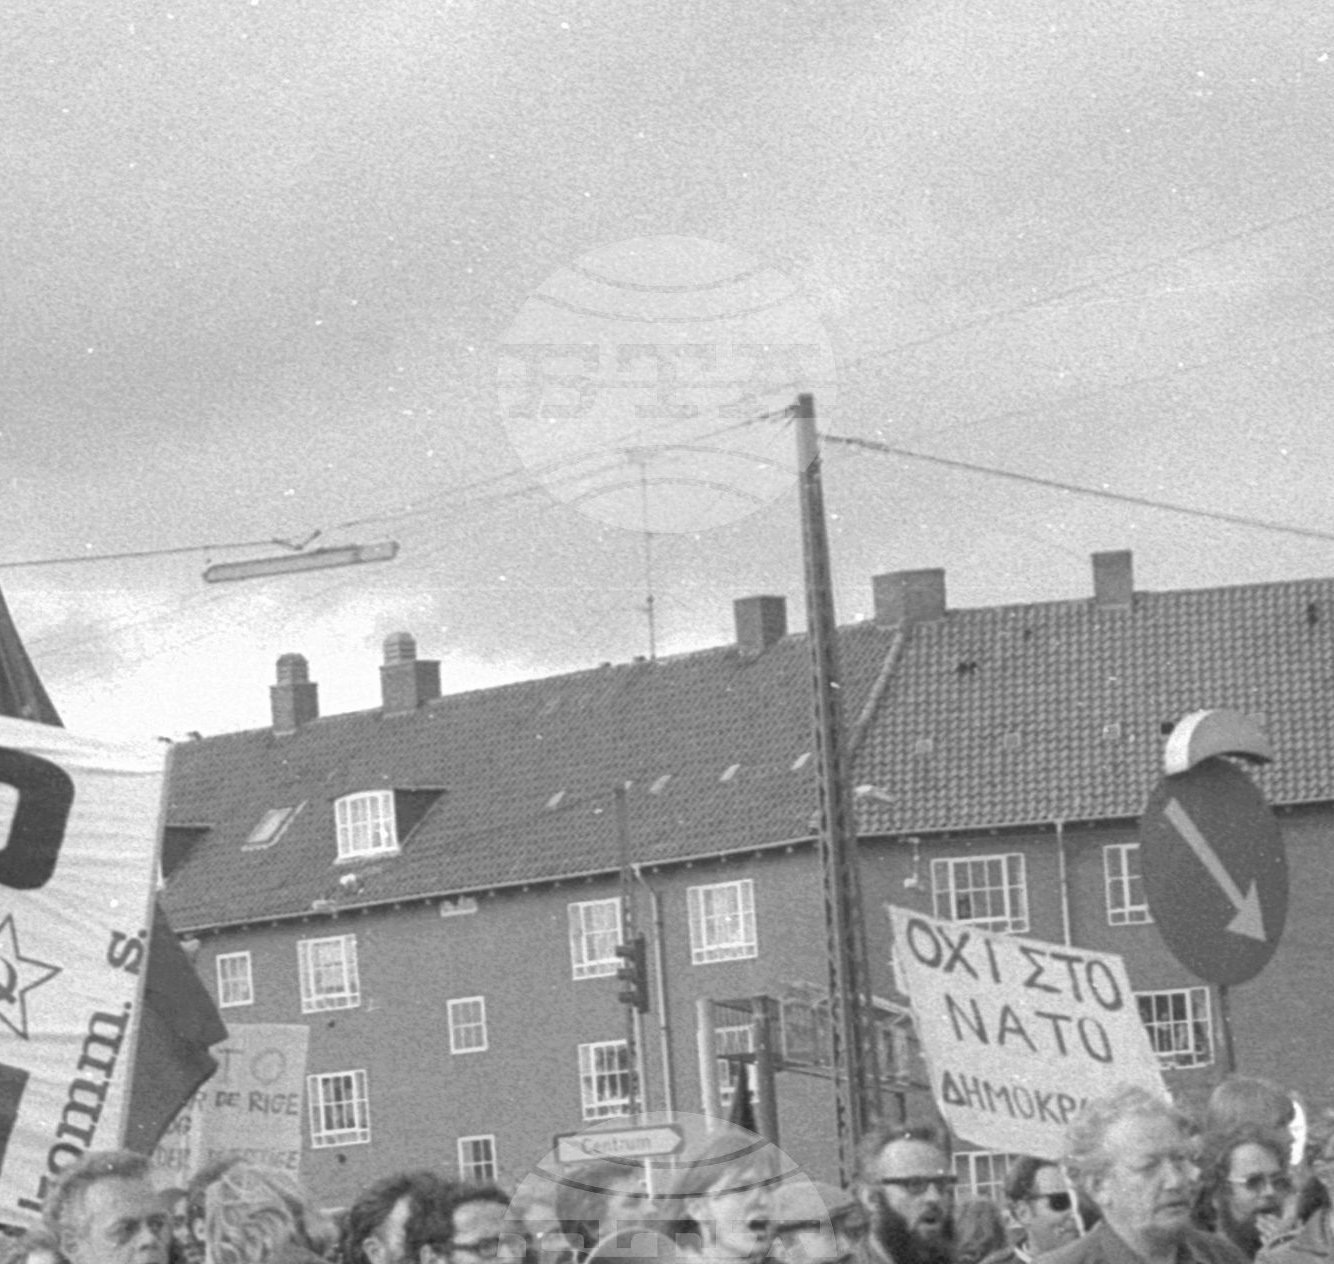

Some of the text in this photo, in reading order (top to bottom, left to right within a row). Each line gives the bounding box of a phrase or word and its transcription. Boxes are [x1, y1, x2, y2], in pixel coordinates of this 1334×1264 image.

[905, 917, 1124, 1012] ΟΧΙ ΣΤΟ
[218, 1047, 287, 1086] TO
[941, 1070, 1086, 1126] ΔΗΜΟΚΡ
